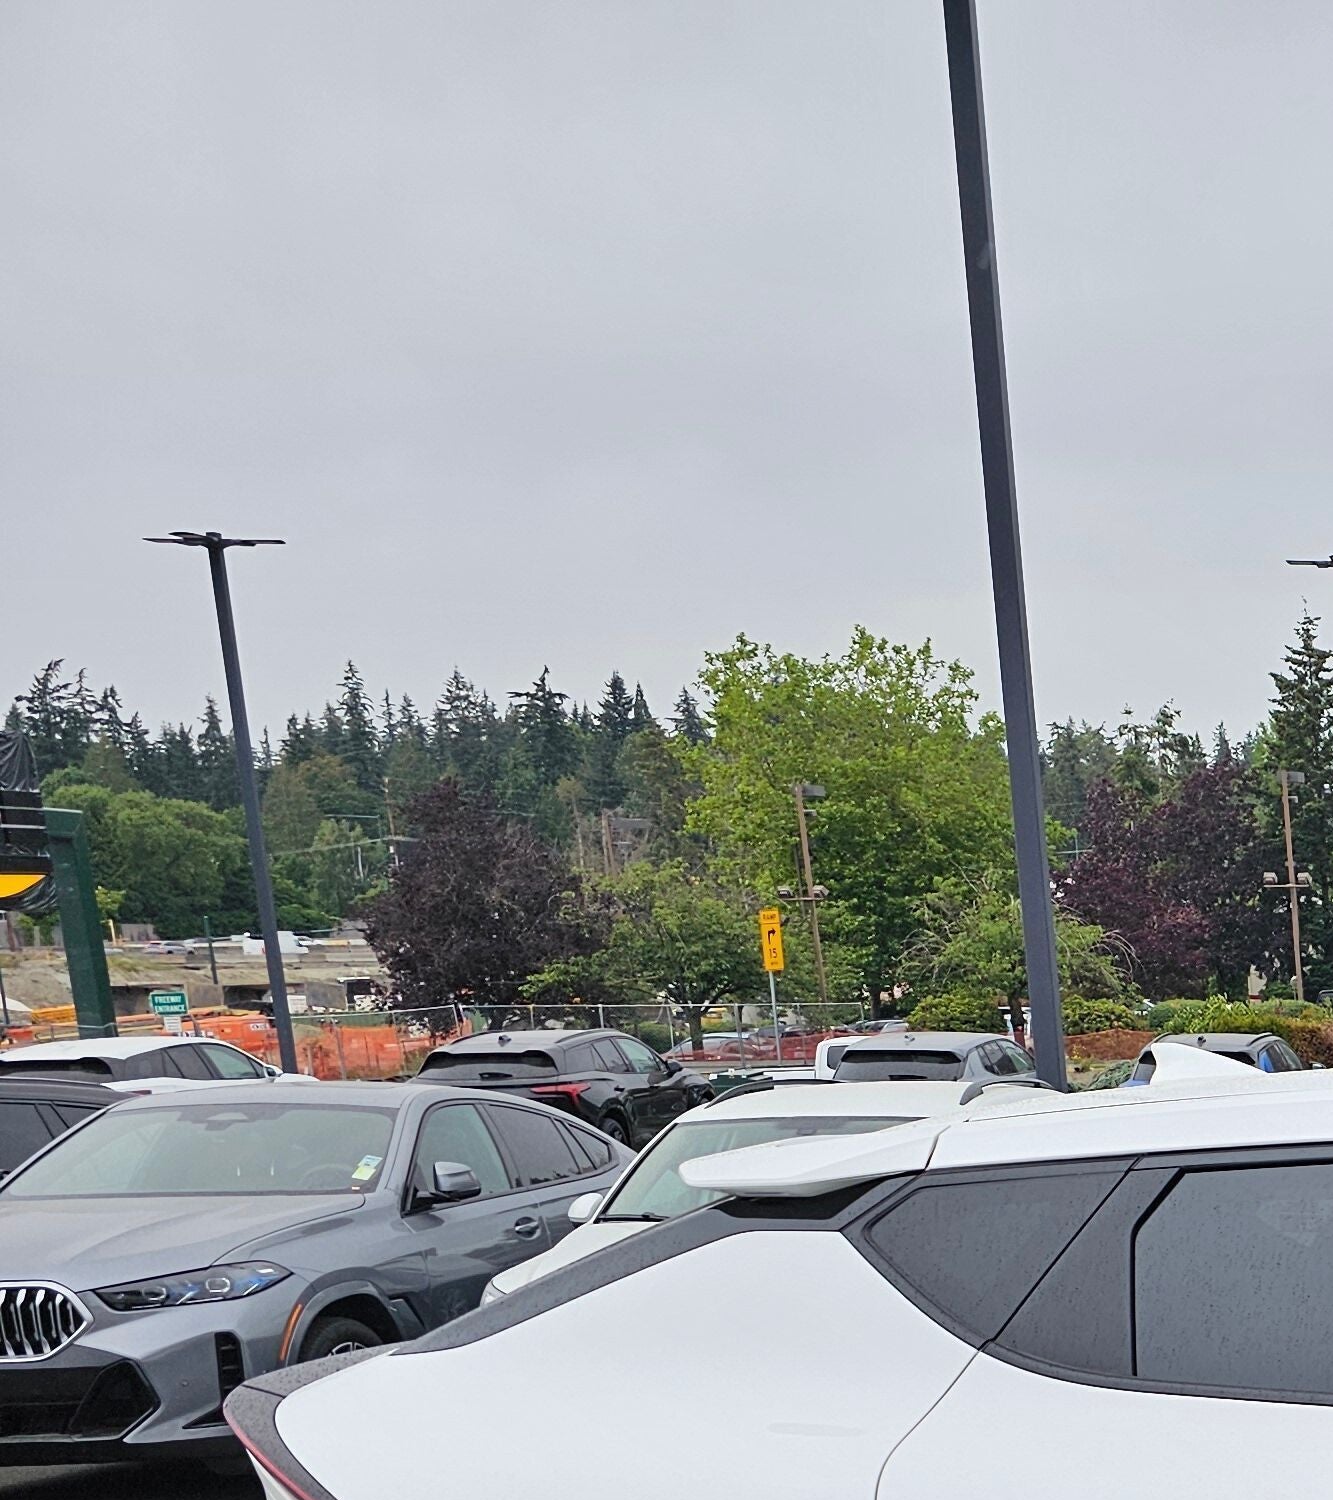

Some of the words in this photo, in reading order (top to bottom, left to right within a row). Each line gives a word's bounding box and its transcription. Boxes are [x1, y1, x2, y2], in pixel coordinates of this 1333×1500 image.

[769, 947, 778, 959] 15
[154, 995, 182, 1003] FREEWAY
[155, 1004, 186, 1012] ENTRANCE
